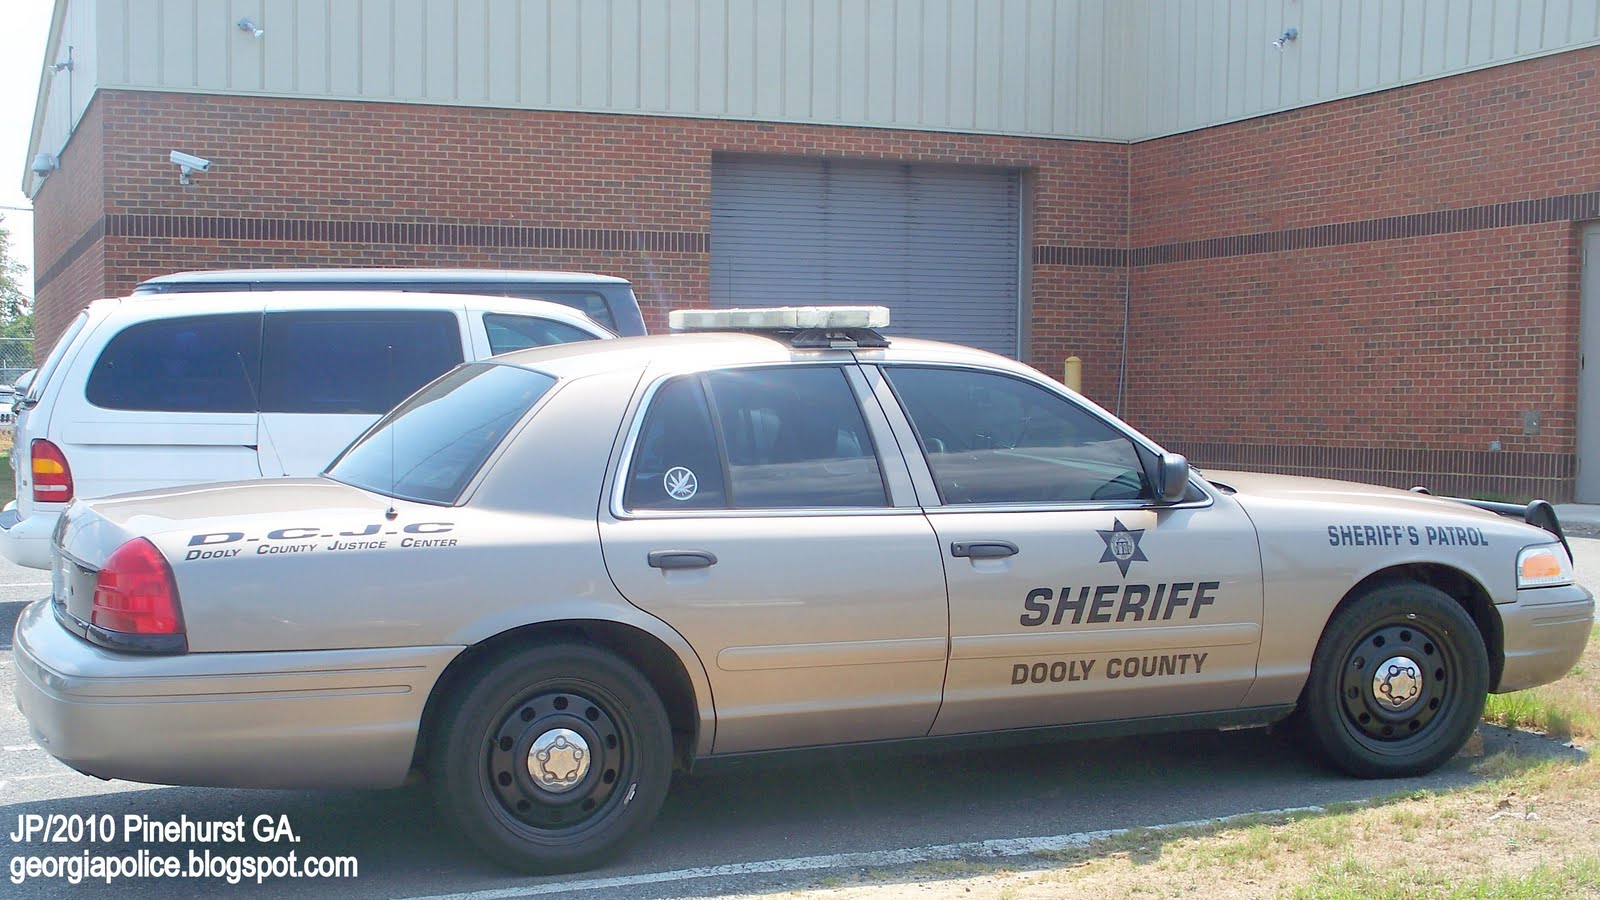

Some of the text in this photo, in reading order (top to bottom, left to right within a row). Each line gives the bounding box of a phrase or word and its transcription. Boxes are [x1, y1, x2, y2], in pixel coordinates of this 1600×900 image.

[185, 537, 458, 561] DOOLY COUNTY JUSTICE CENTER
[1327, 525, 1489, 547] SHERIFF'S PATROL
[1019, 581, 1221, 627] SHERIFF
[1011, 652, 1208, 685] DOOLY COUNTY
